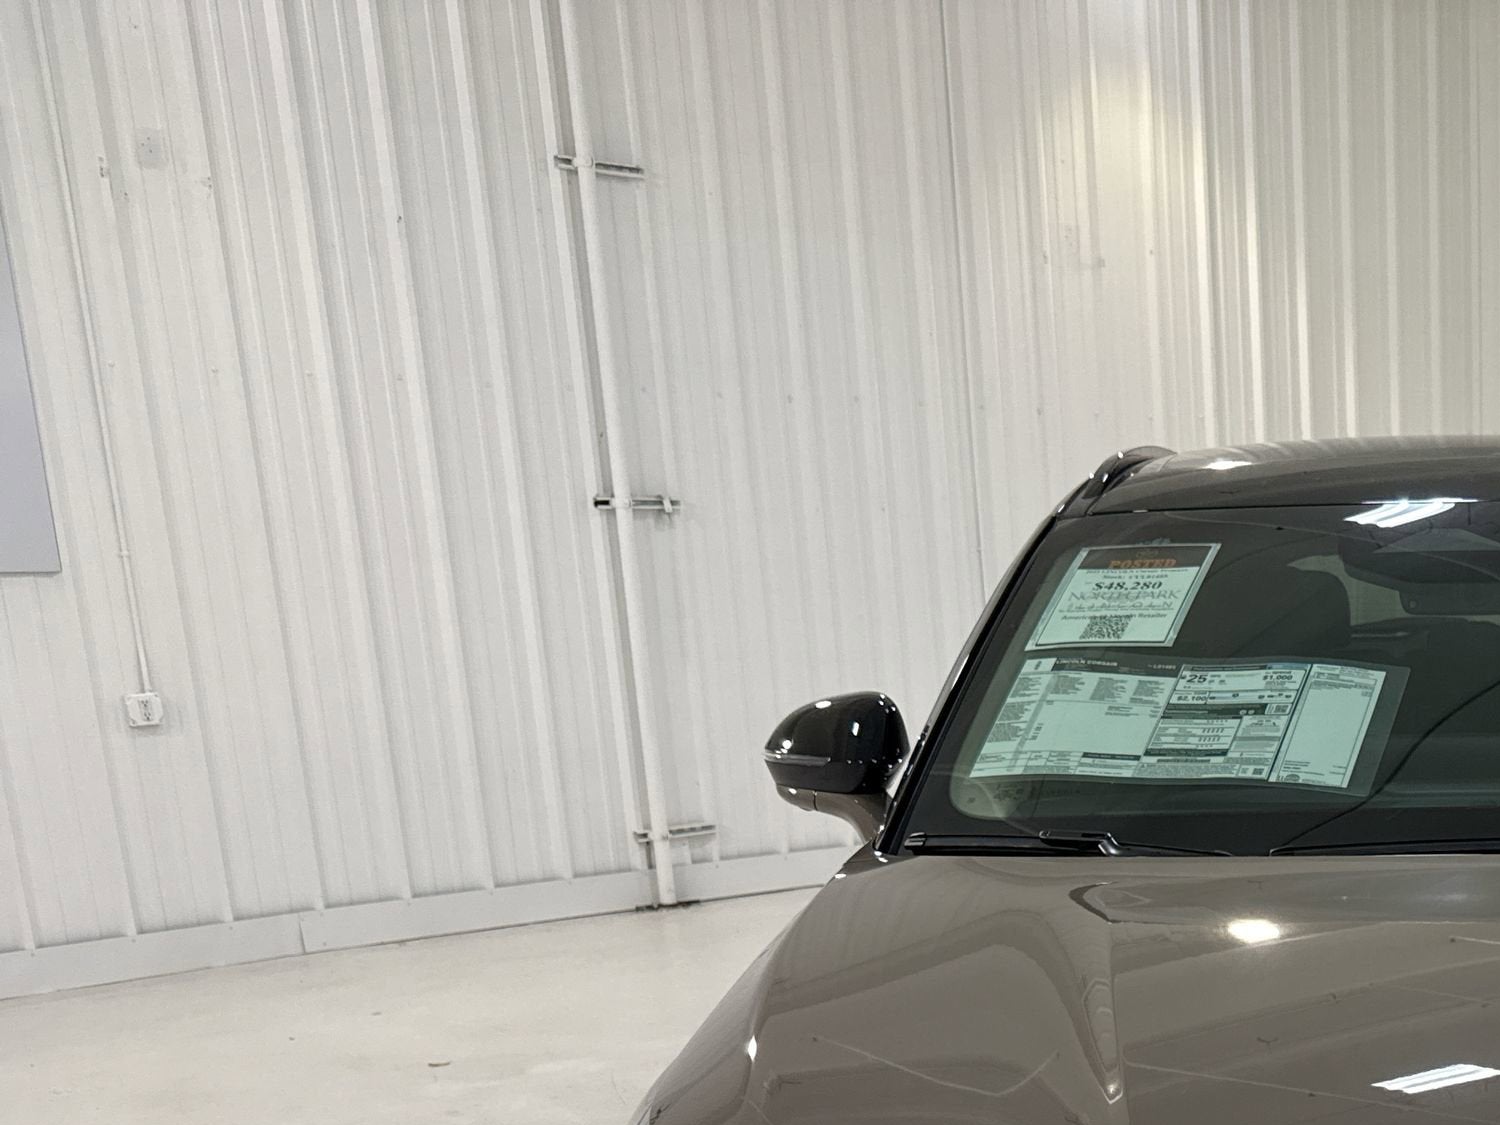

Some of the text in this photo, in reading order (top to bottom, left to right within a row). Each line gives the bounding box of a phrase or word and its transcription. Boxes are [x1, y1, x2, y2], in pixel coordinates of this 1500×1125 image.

[1109, 558, 1177, 568] POSTED
[1092, 581, 1163, 591] $48,280
[1186, 674, 1208, 683] 25
